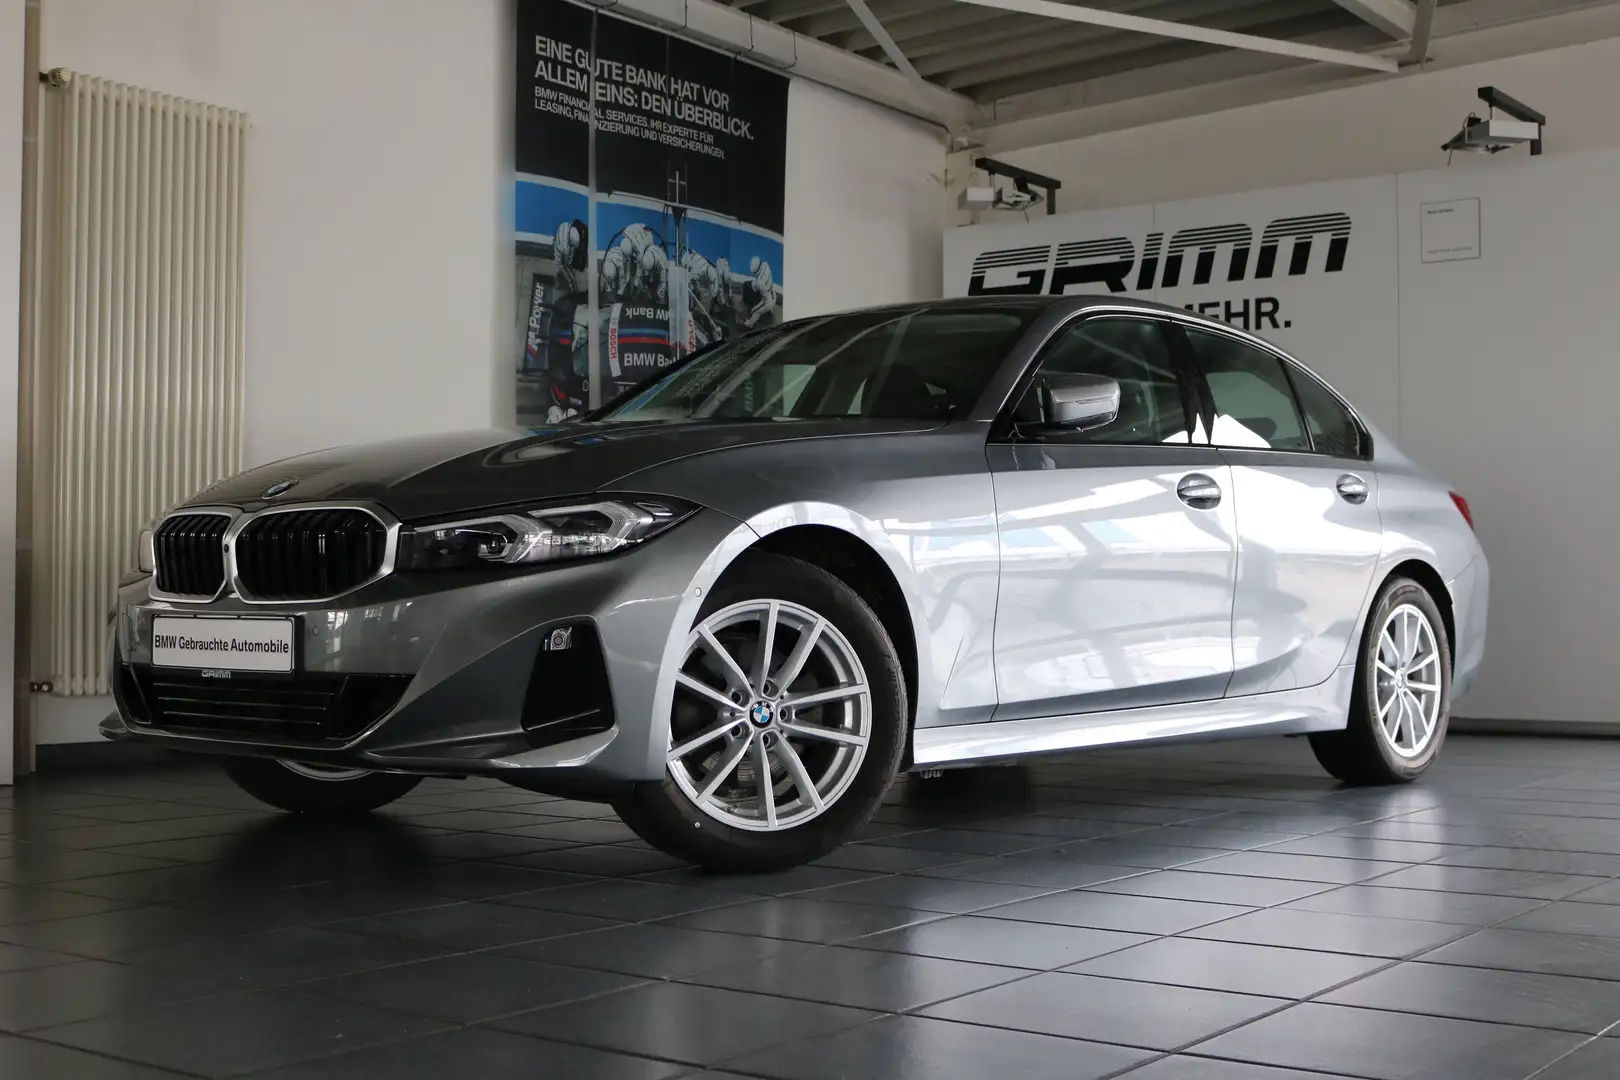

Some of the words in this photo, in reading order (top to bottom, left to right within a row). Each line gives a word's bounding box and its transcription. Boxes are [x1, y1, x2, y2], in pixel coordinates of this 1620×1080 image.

[534, 60, 588, 94] ALLEM
[596, 81, 638, 108] EINS:
[641, 91, 671, 117] DEN
[674, 95, 754, 140] ÜBERBLICK.
[535, 35, 572, 64] EINE
[575, 48, 623, 82] GUTE
[626, 64, 667, 92] BANK
[670, 76, 701, 101] HAT
[702, 85, 729, 112] VOR
[534, 86, 557, 101] BMW
[558, 92, 604, 119] FINANCIAL
[605, 109, 649, 128] SERVICES.
[650, 117, 662, 131] IHR
[662, 122, 698, 141] EXPERTE
[699, 130, 714, 145] FÜR
[534, 98, 573, 120] LEASING,
[573, 110, 640, 138] FINANZIERUNG
[640, 126, 657, 141] UND
[657, 130, 726, 160] VERSICHERUNGEN.
[967, 212, 1352, 296] GRIMM
[529, 282, 544, 329] Power
[625, 307, 654, 319] Bank
[1184, 297, 1292, 330] EHR.
[624, 353, 655, 367] BMW
[155, 635, 177, 649] BMW
[179, 636, 228, 651] Gebrauchte
[231, 638, 289, 653] Automobile
